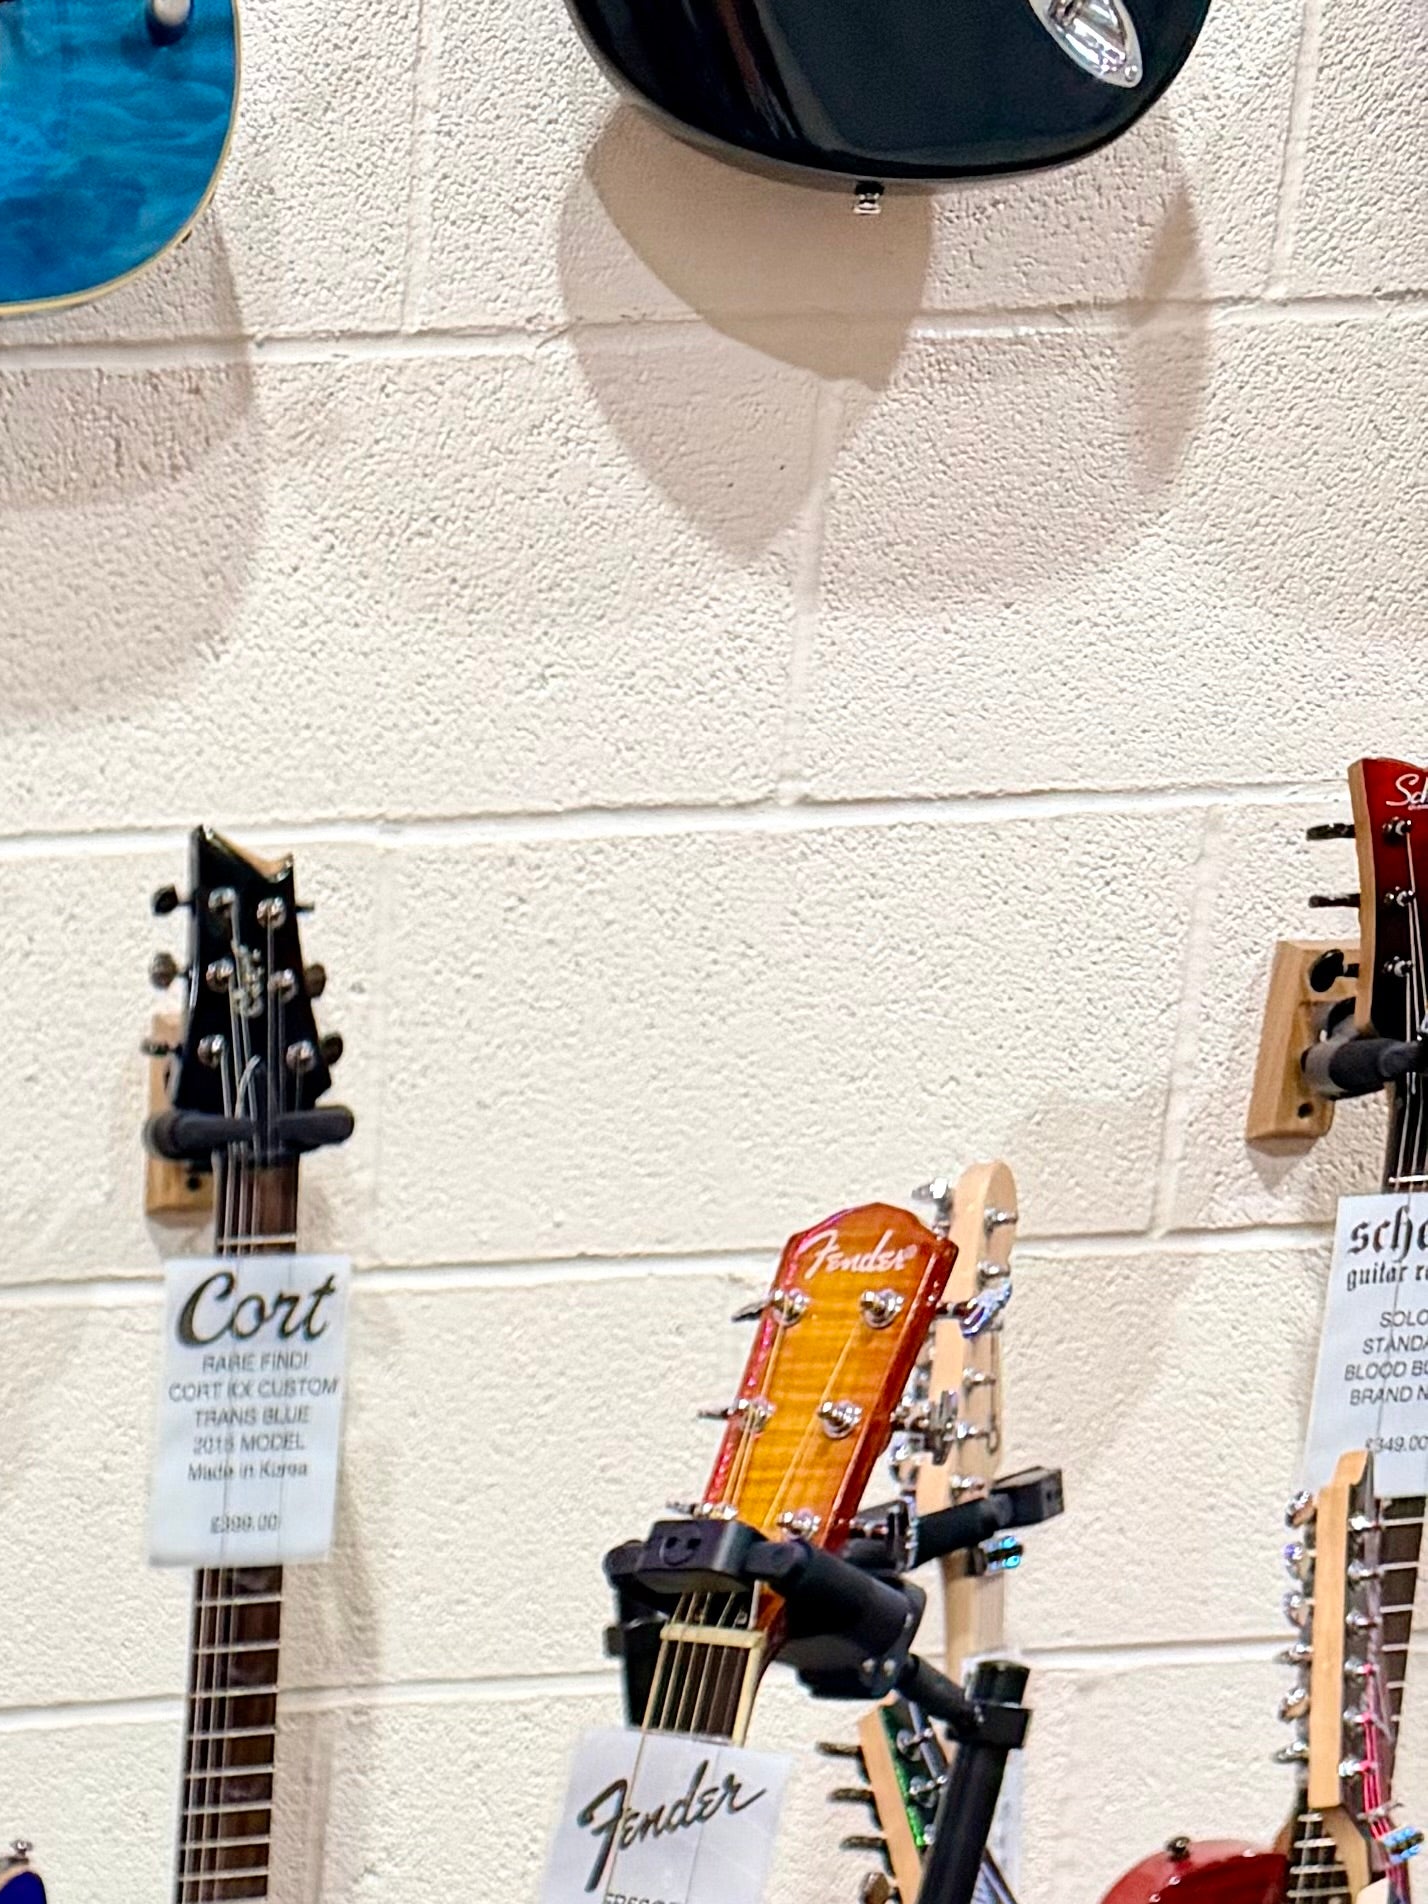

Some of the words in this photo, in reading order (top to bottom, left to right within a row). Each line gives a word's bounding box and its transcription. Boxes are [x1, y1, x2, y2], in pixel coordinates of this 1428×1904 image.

[796, 1229, 914, 1280] Fender
[1347, 1261, 1409, 1292] guitar
[175, 1271, 336, 1348] Cort
[201, 1354, 255, 1373] RARE
[1344, 1361, 1407, 1382] BLOOD
[169, 1382, 222, 1402] CORT
[257, 1377, 340, 1399] CUSTOM
[1350, 1385, 1413, 1406] BRAND
[194, 1408, 257, 1428] TRANS
[262, 1405, 310, 1425] BLUE
[239, 1432, 305, 1452] MODEL
[188, 1463, 234, 1481] Made
[239, 1462, 255, 1480] in
[259, 1461, 309, 1479] Korea
[576, 1760, 768, 1893] Fender
